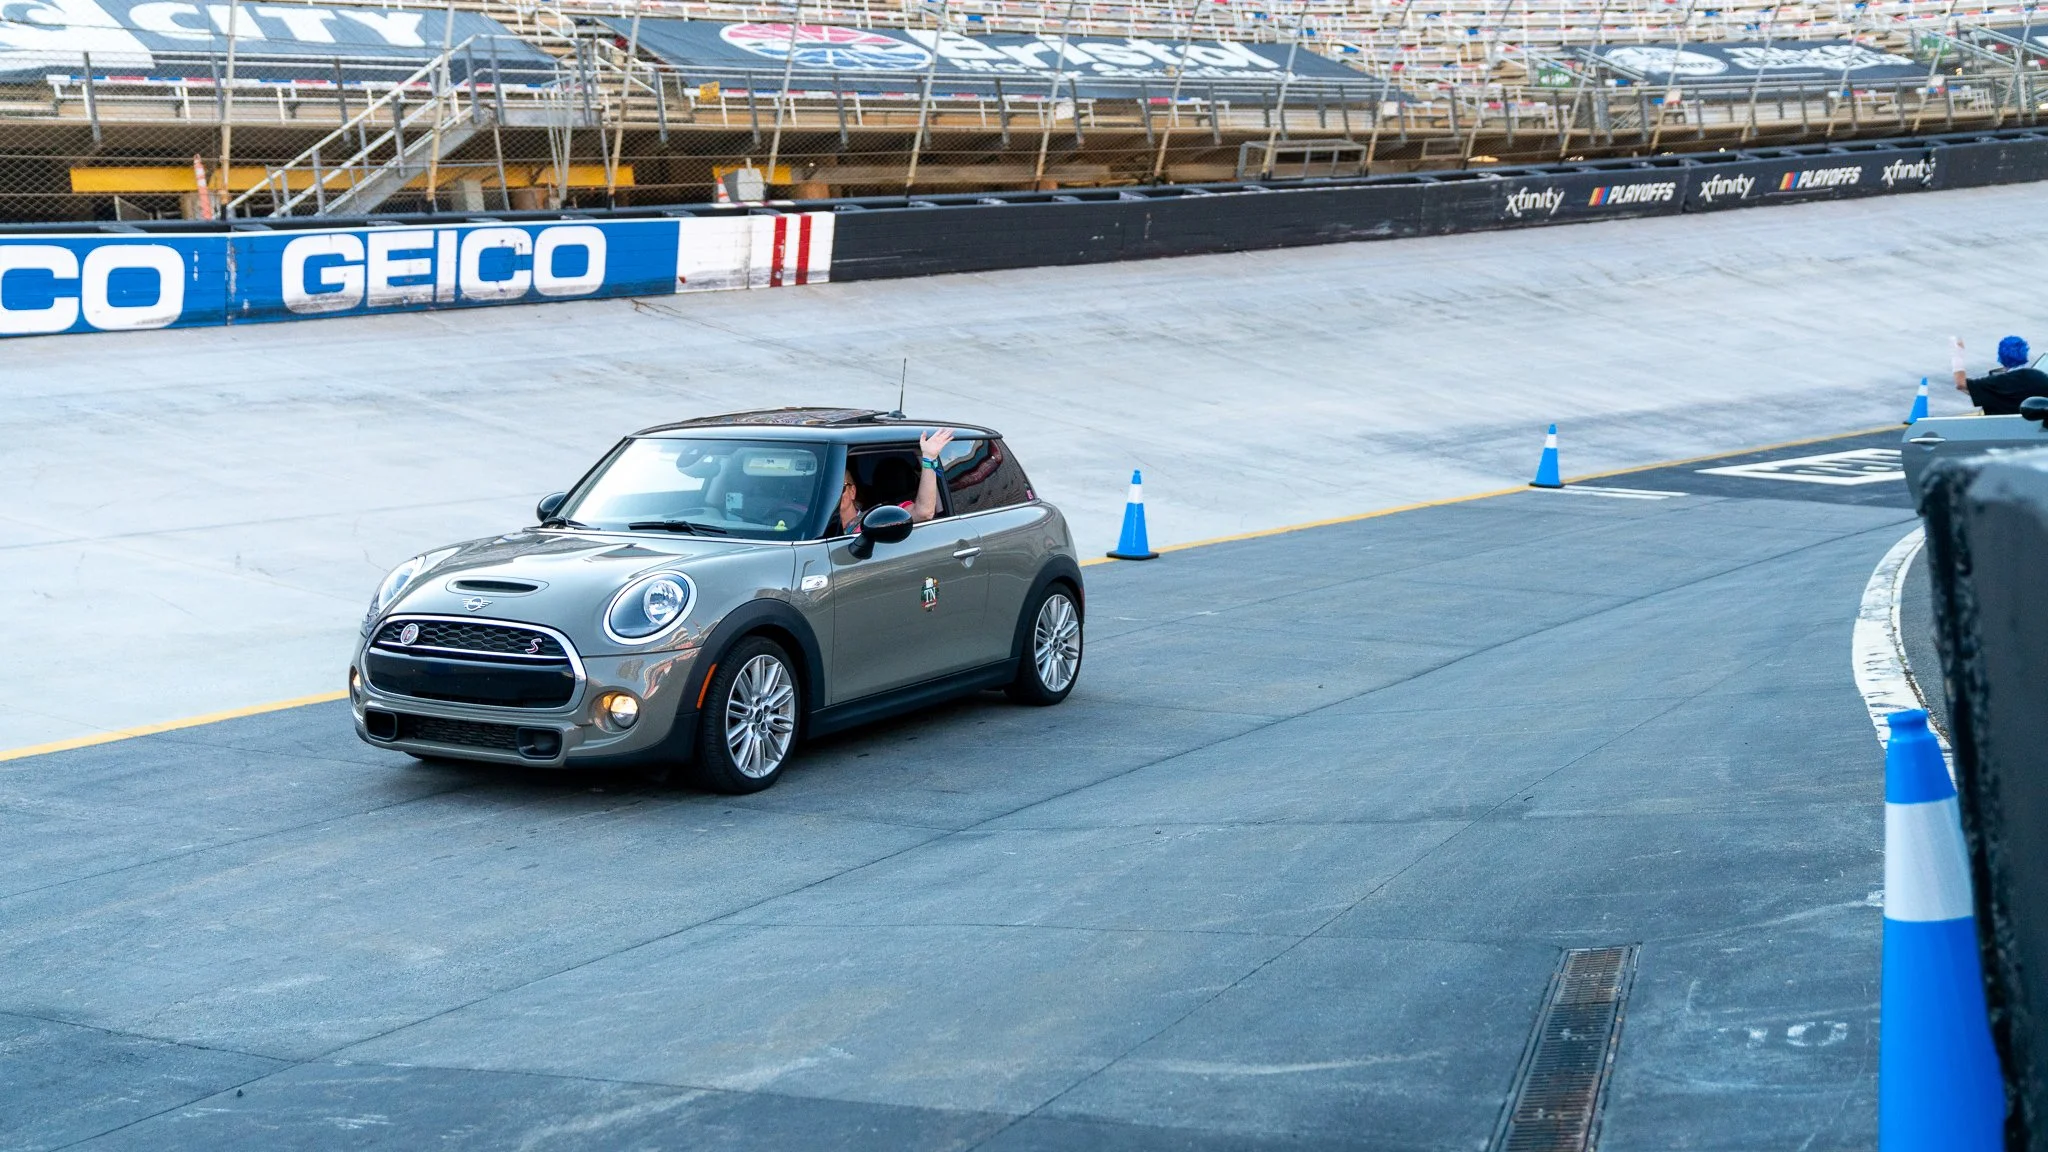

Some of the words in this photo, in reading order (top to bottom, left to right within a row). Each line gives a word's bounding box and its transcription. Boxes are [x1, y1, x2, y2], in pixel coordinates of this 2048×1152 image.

[129, 1, 427, 47] CITY
[904, 28, 1280, 69] Bristol
[1699, 173, 1755, 202] xfinity
[1797, 166, 1862, 188] PLAYOFFS
[1505, 187, 1565, 217] xfinity
[1607, 182, 1676, 204] PLAYOFFS
[281, 226, 607, 314] GEICO
[525, 638, 542, 654] S
